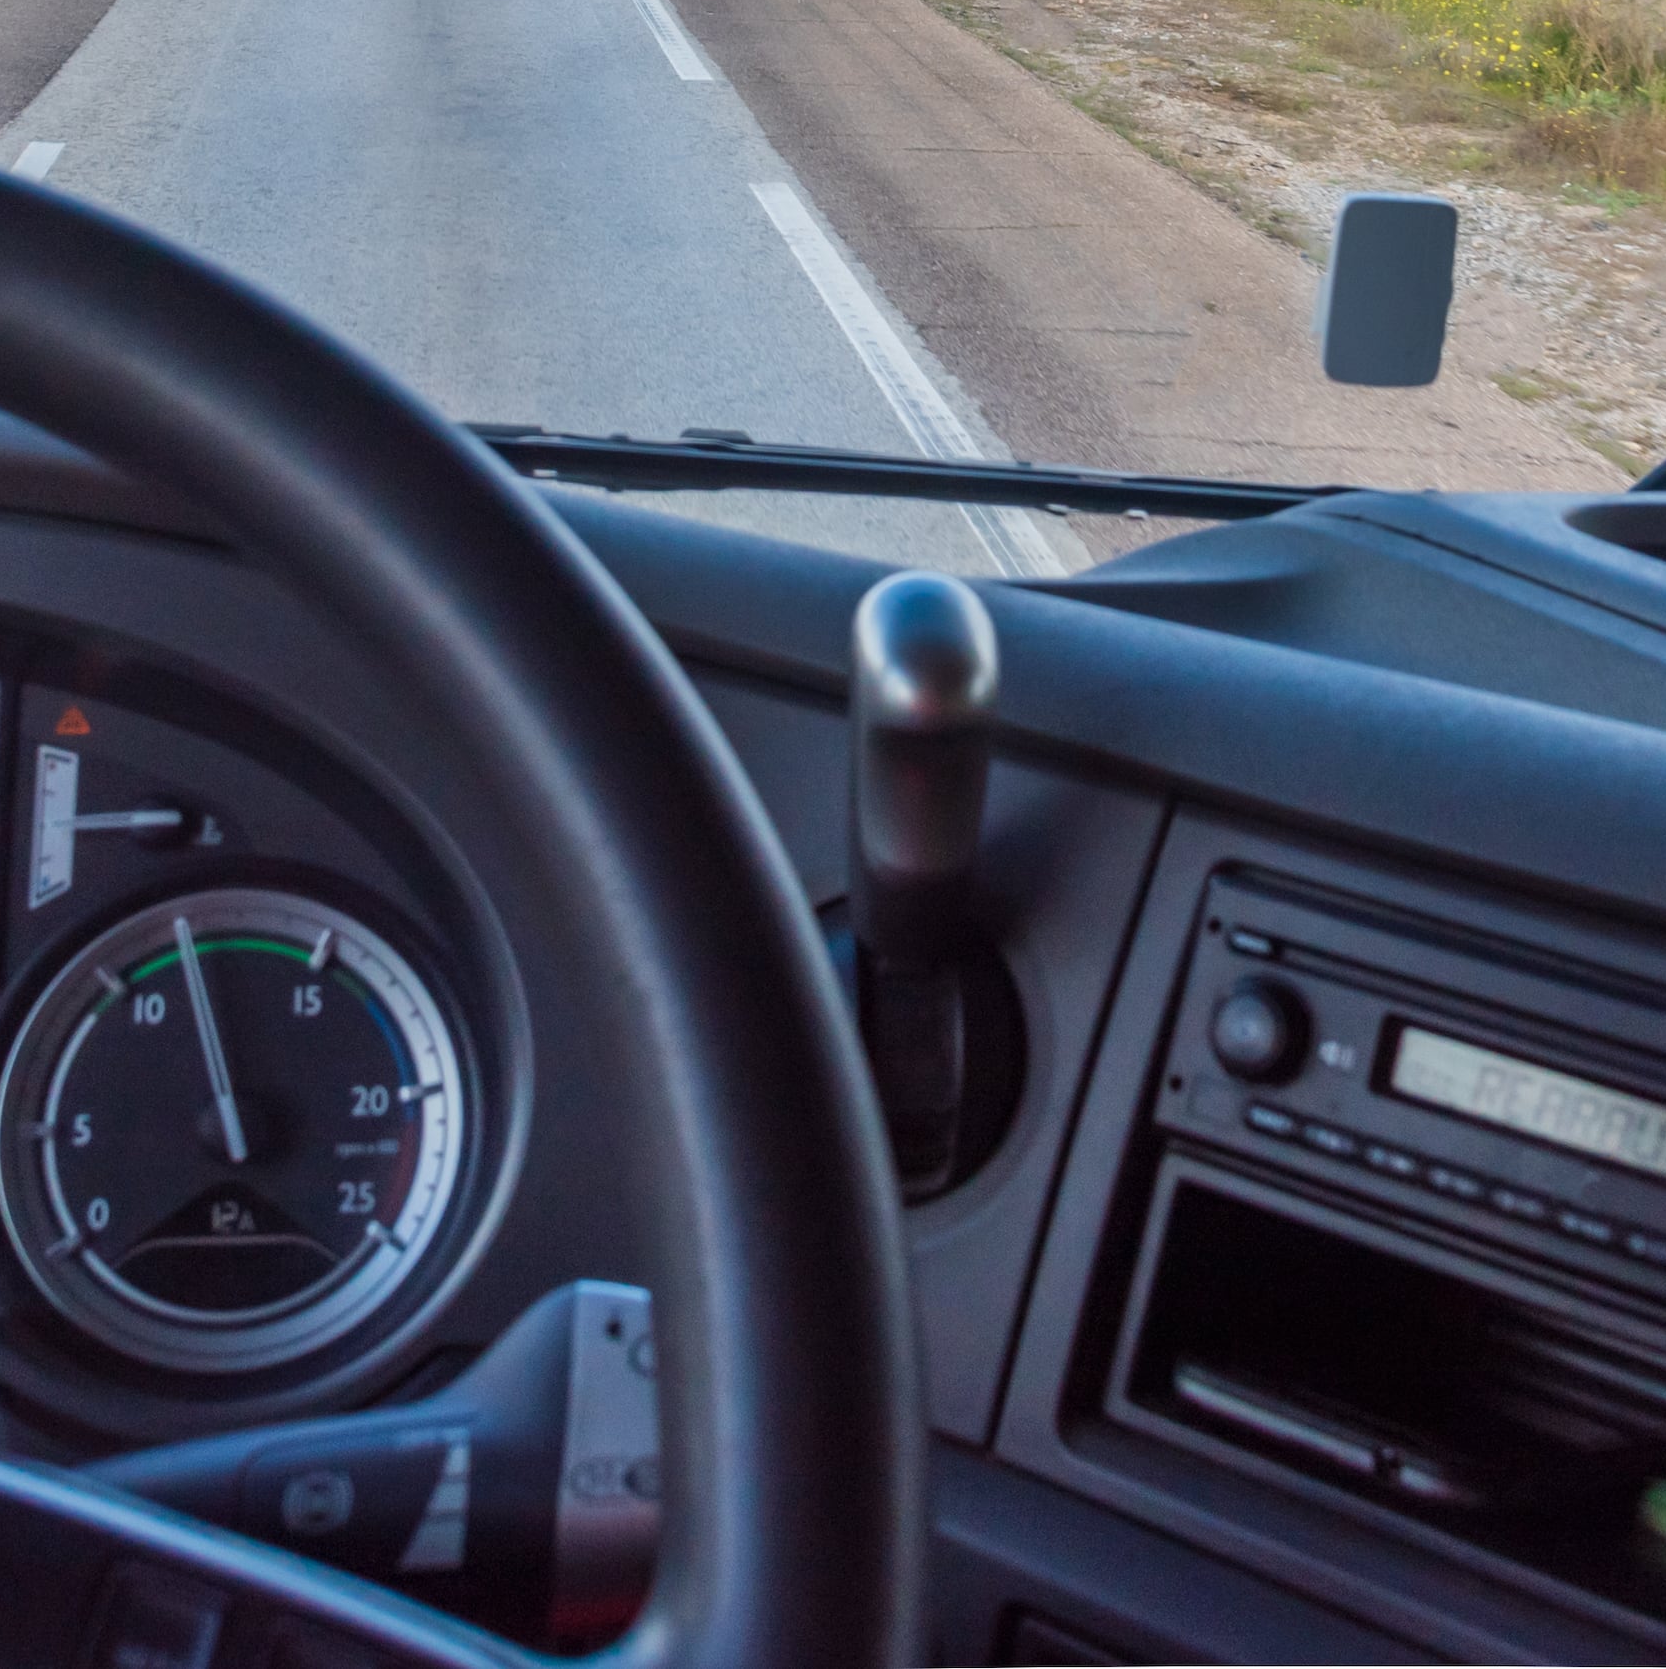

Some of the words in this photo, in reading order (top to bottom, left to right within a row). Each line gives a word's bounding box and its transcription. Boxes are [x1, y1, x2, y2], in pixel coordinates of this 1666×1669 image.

[133, 992, 166, 1025] 10
[293, 984, 323, 1017] 15
[350, 1084, 390, 1117] 20
[72, 1113, 92, 1147] 5
[86, 1197, 110, 1230] 0
[338, 1181, 376, 1214] 25
